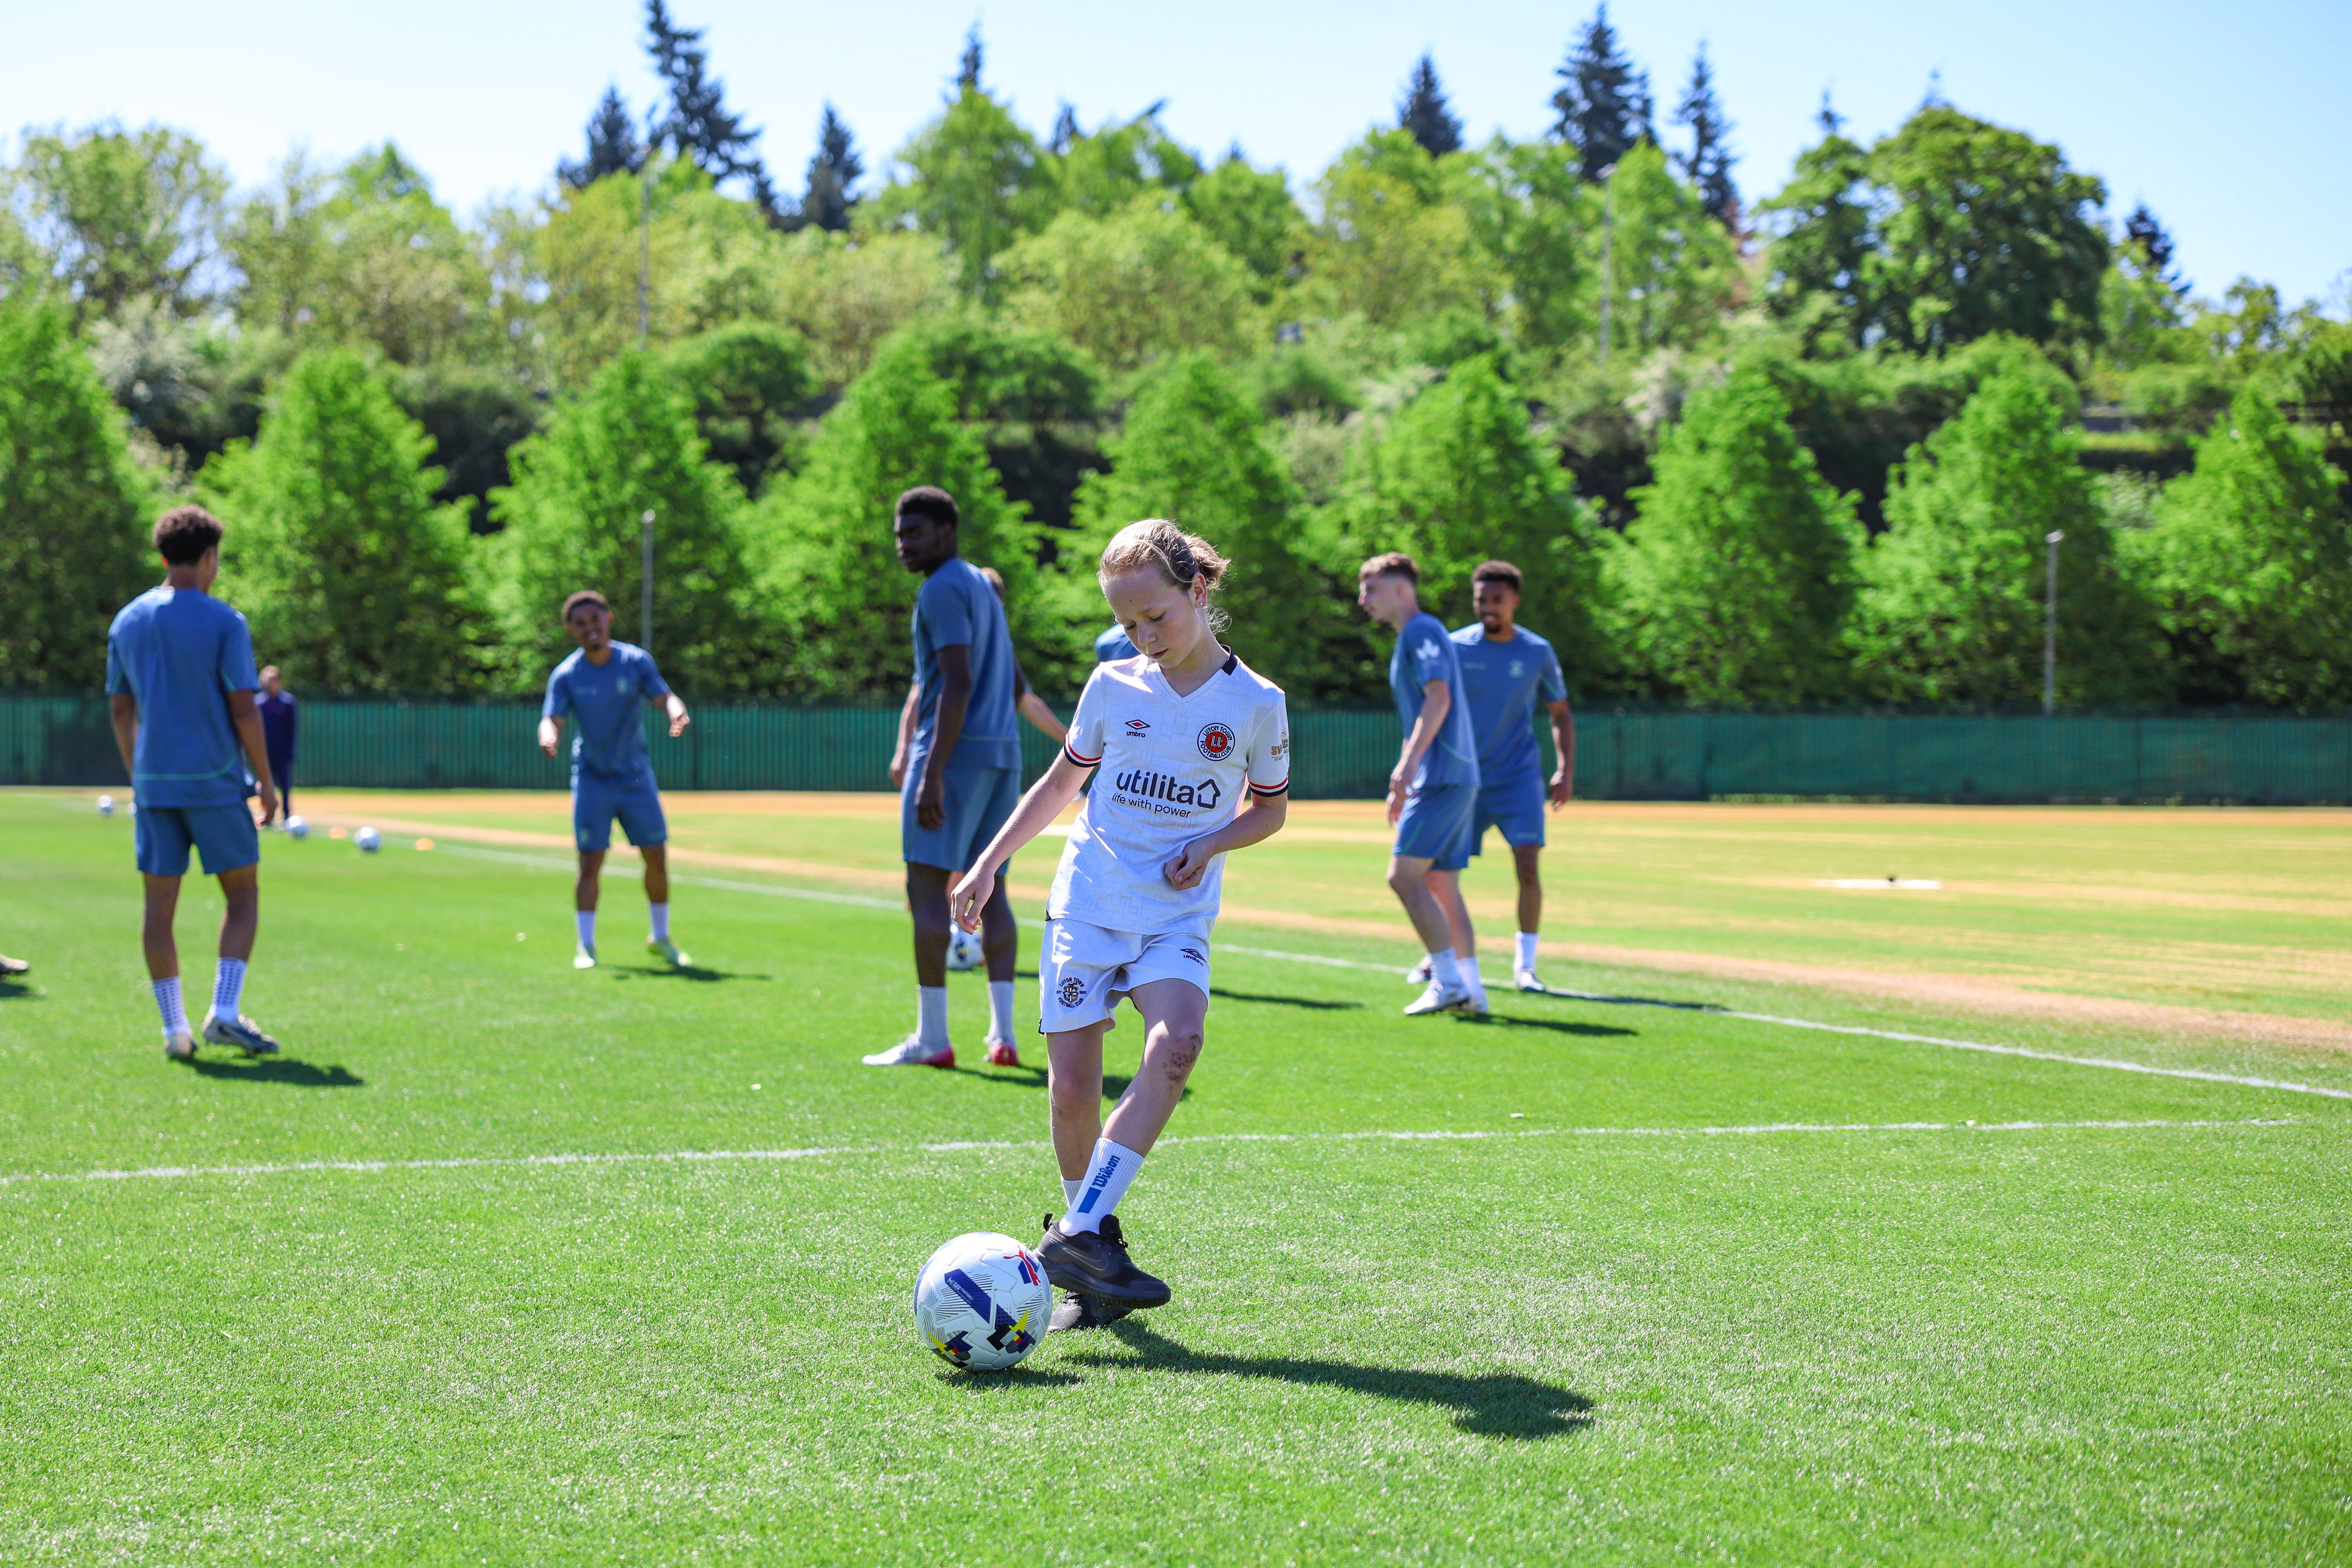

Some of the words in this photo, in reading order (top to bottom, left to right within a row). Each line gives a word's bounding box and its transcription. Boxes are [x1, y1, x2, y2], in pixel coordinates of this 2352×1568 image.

[1202, 726, 1219, 737] LUTON
[1220, 726, 1232, 740] TOWN
[1200, 740, 1221, 758] FOOTBALL
[1221, 746, 1231, 757] CLUB
[1116, 769, 1194, 805] utilita
[1112, 792, 1125, 804] life
[1129, 799, 1151, 810] with
[1154, 804, 1191, 818] power
[1183, 955, 1203, 967] umbro
[1059, 977, 1072, 987] LUTON
[1073, 977, 1085, 987] TOWN
[1058, 997, 1075, 1008] FOOTBALL
[1075, 998, 1084, 1006] CLUB
[1092, 1155, 1120, 1187] Wilson
[960, 1287, 974, 1301] FOOTBALL
